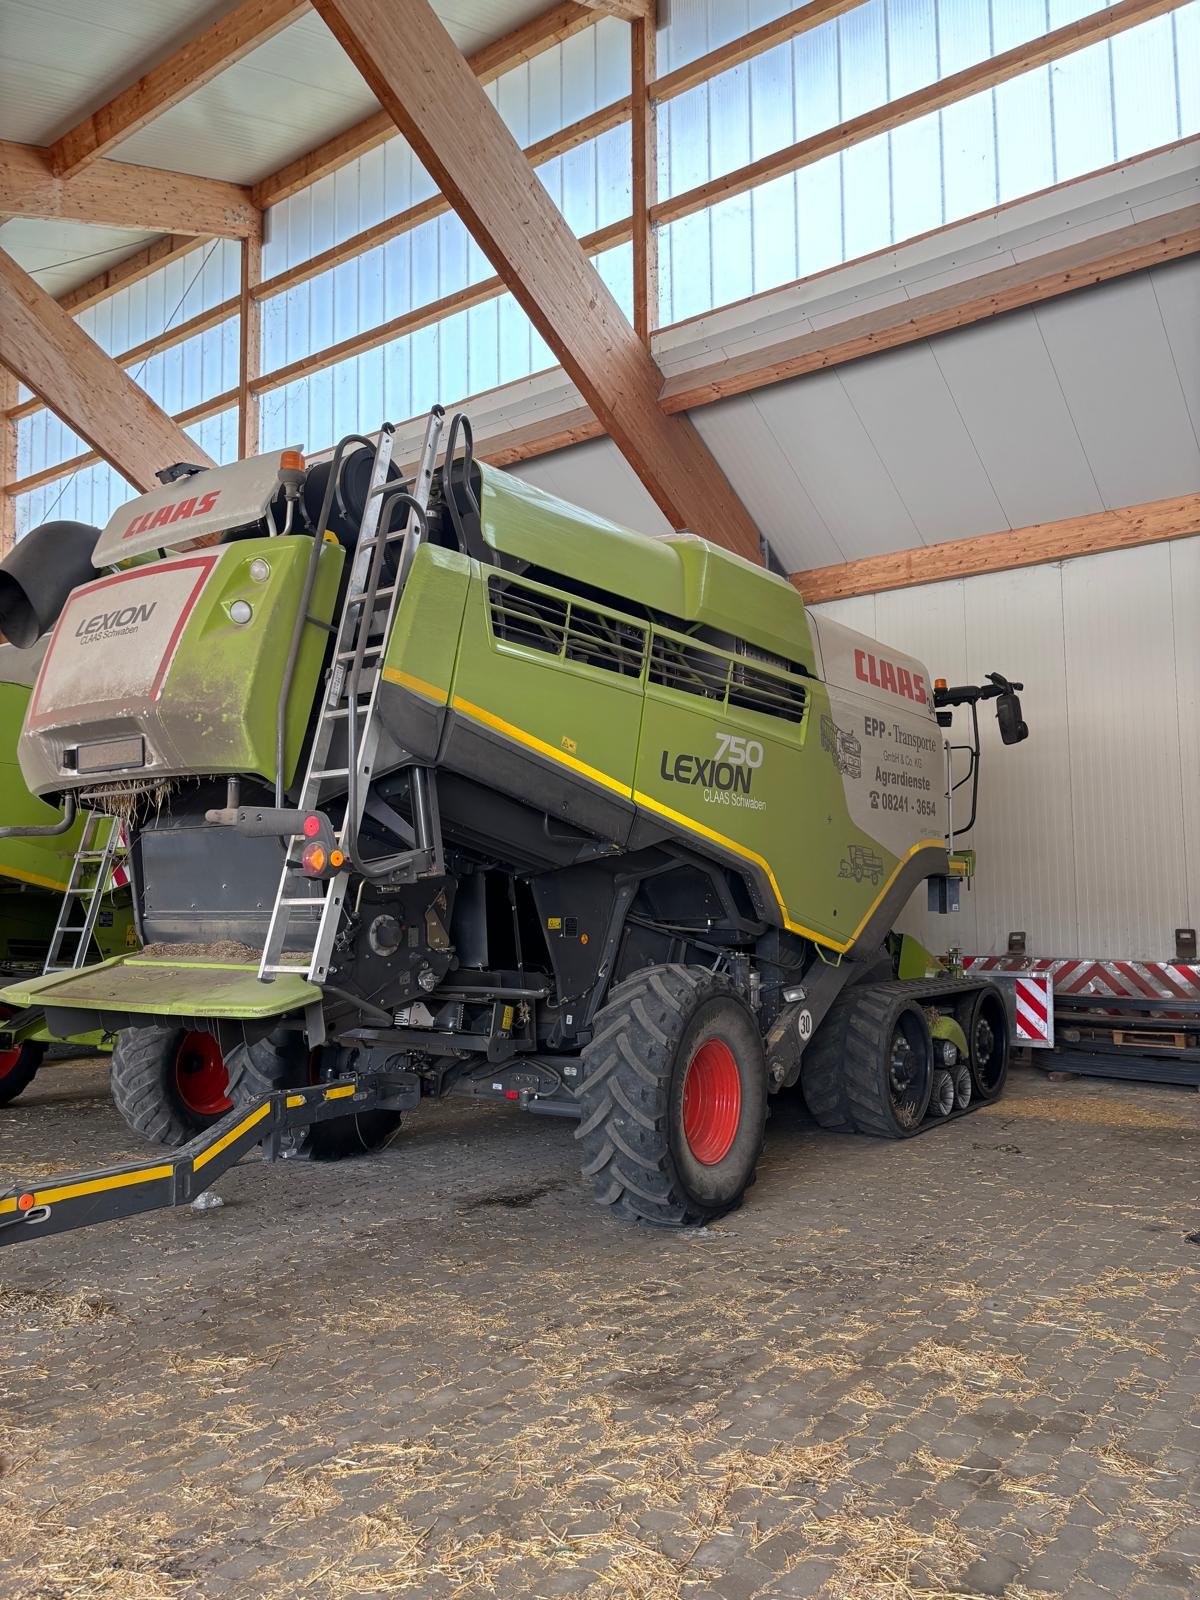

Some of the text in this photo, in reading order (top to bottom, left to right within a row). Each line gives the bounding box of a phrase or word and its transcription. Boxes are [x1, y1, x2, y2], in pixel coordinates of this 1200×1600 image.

[122, 490, 222, 539] CLAAS
[75, 602, 157, 637] LEXION
[80, 631, 103, 646] CLAAS
[854, 648, 927, 705] CLAAS
[714, 732, 764, 769] 750
[864, 716, 886, 738] EPP
[893, 724, 937, 753] Transporte
[660, 750, 753, 794] LEXION
[875, 766, 931, 791] Agrardienste
[703, 788, 767, 811] CLAAS Schwaben
[881, 793, 909, 813] 08241
[916, 798, 936, 817] 3654
[800, 1014, 810, 1034] 30
